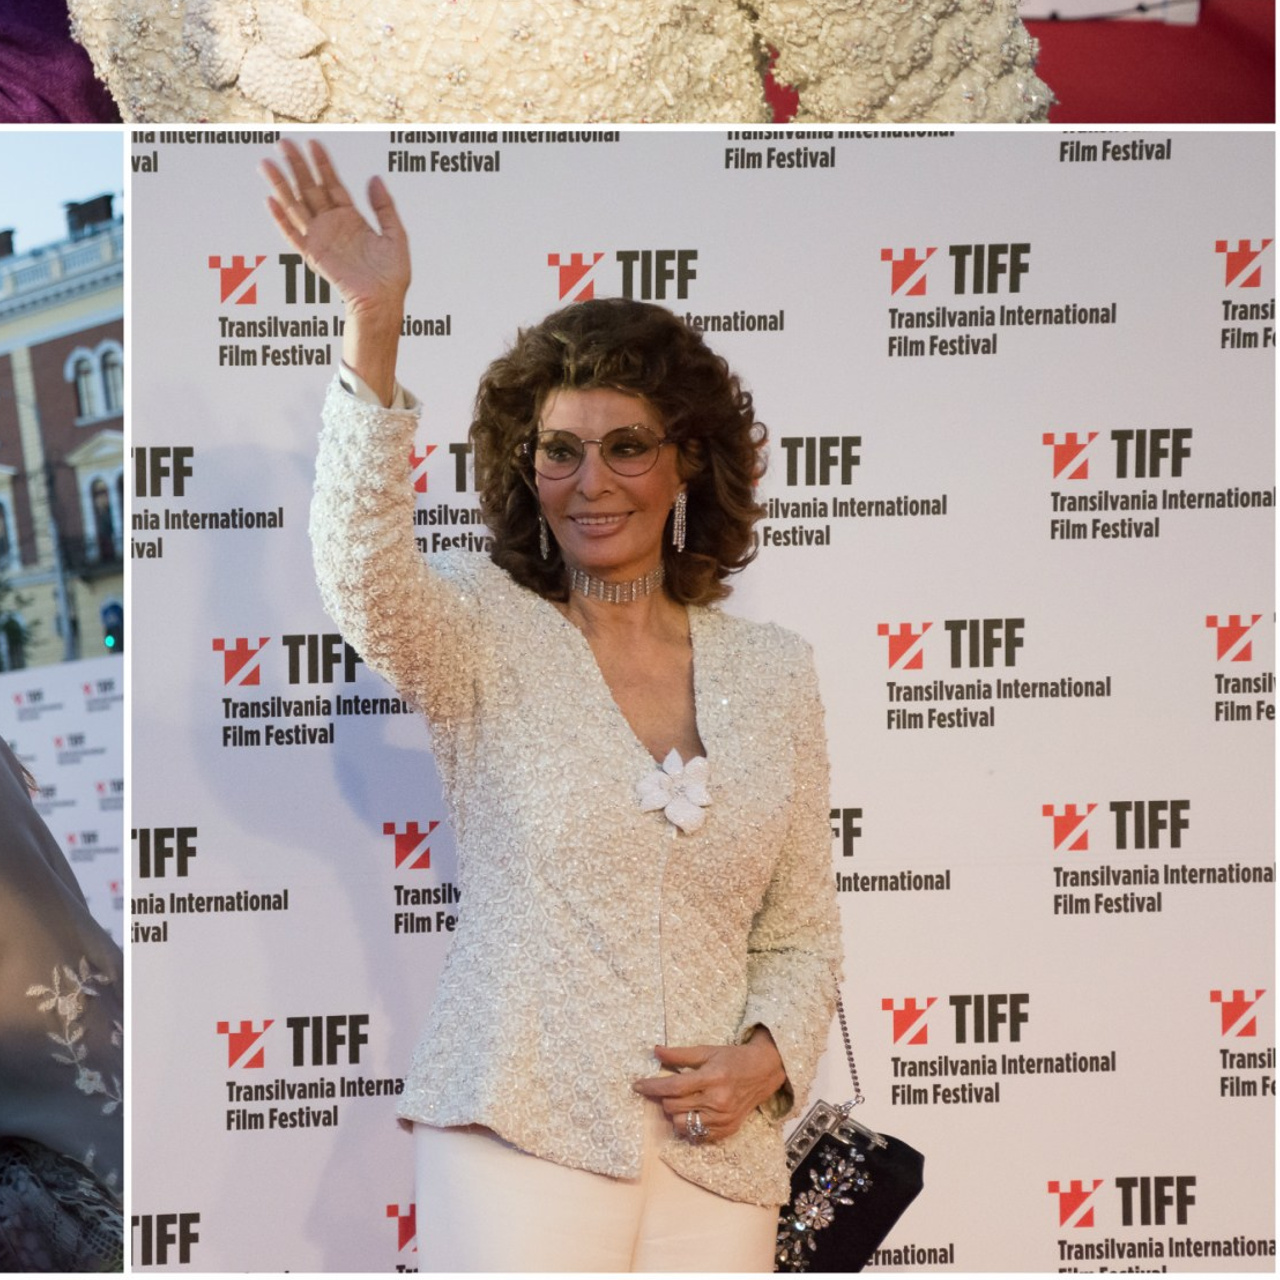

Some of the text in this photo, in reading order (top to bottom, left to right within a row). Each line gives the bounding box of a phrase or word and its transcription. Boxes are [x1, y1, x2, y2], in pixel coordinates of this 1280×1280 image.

[388, 150, 500, 172] Film Festival
[724, 147, 835, 169] Film Festival
[1059, 139, 1172, 162] Film Festival
[616, 250, 698, 300] TIFF
[949, 243, 1031, 294] TIFF
[218, 316, 329, 338] Transilvania
[888, 303, 1117, 329] Transilvania International
[888, 334, 997, 357] Film Festival
[1221, 328, 1258, 349] Film
[218, 344, 331, 366] Film Festival
[781, 436, 862, 487] TIFF
[1111, 428, 1193, 478] TIFF
[131, 447, 194, 498] IFF
[832, 495, 947, 517] International
[1051, 491, 1158, 512] Transilvania
[164, 507, 284, 530] International
[1050, 517, 1160, 539] Film Festival
[763, 525, 831, 547] Festival
[944, 618, 1025, 668] TIFF
[887, 676, 1111, 702] Transilvania International
[222, 696, 332, 719] Transilvania
[887, 706, 995, 729] Film Festival
[1214, 701, 1251, 721] Film
[222, 723, 334, 747] Film Festival
[1109, 800, 1190, 849] TIFF
[131, 827, 197, 878] IFF
[836, 870, 951, 892] International
[1053, 862, 1275, 887] Transilvania Internationa
[170, 890, 289, 913] International
[1053, 892, 1162, 915] Film Festival
[394, 913, 431, 934] Film
[949, 993, 1029, 1043] TIFF
[286, 1014, 369, 1067] TIFF
[891, 1051, 1116, 1077] Transilvania International
[226, 1078, 336, 1102] Transilvania
[891, 1082, 1000, 1105] Film Festival
[1220, 1076, 1257, 1098] Film
[226, 1106, 338, 1130] Film Festival
[1116, 1176, 1196, 1227] TIFF
[1058, 1238, 1164, 1261] Transilvania
